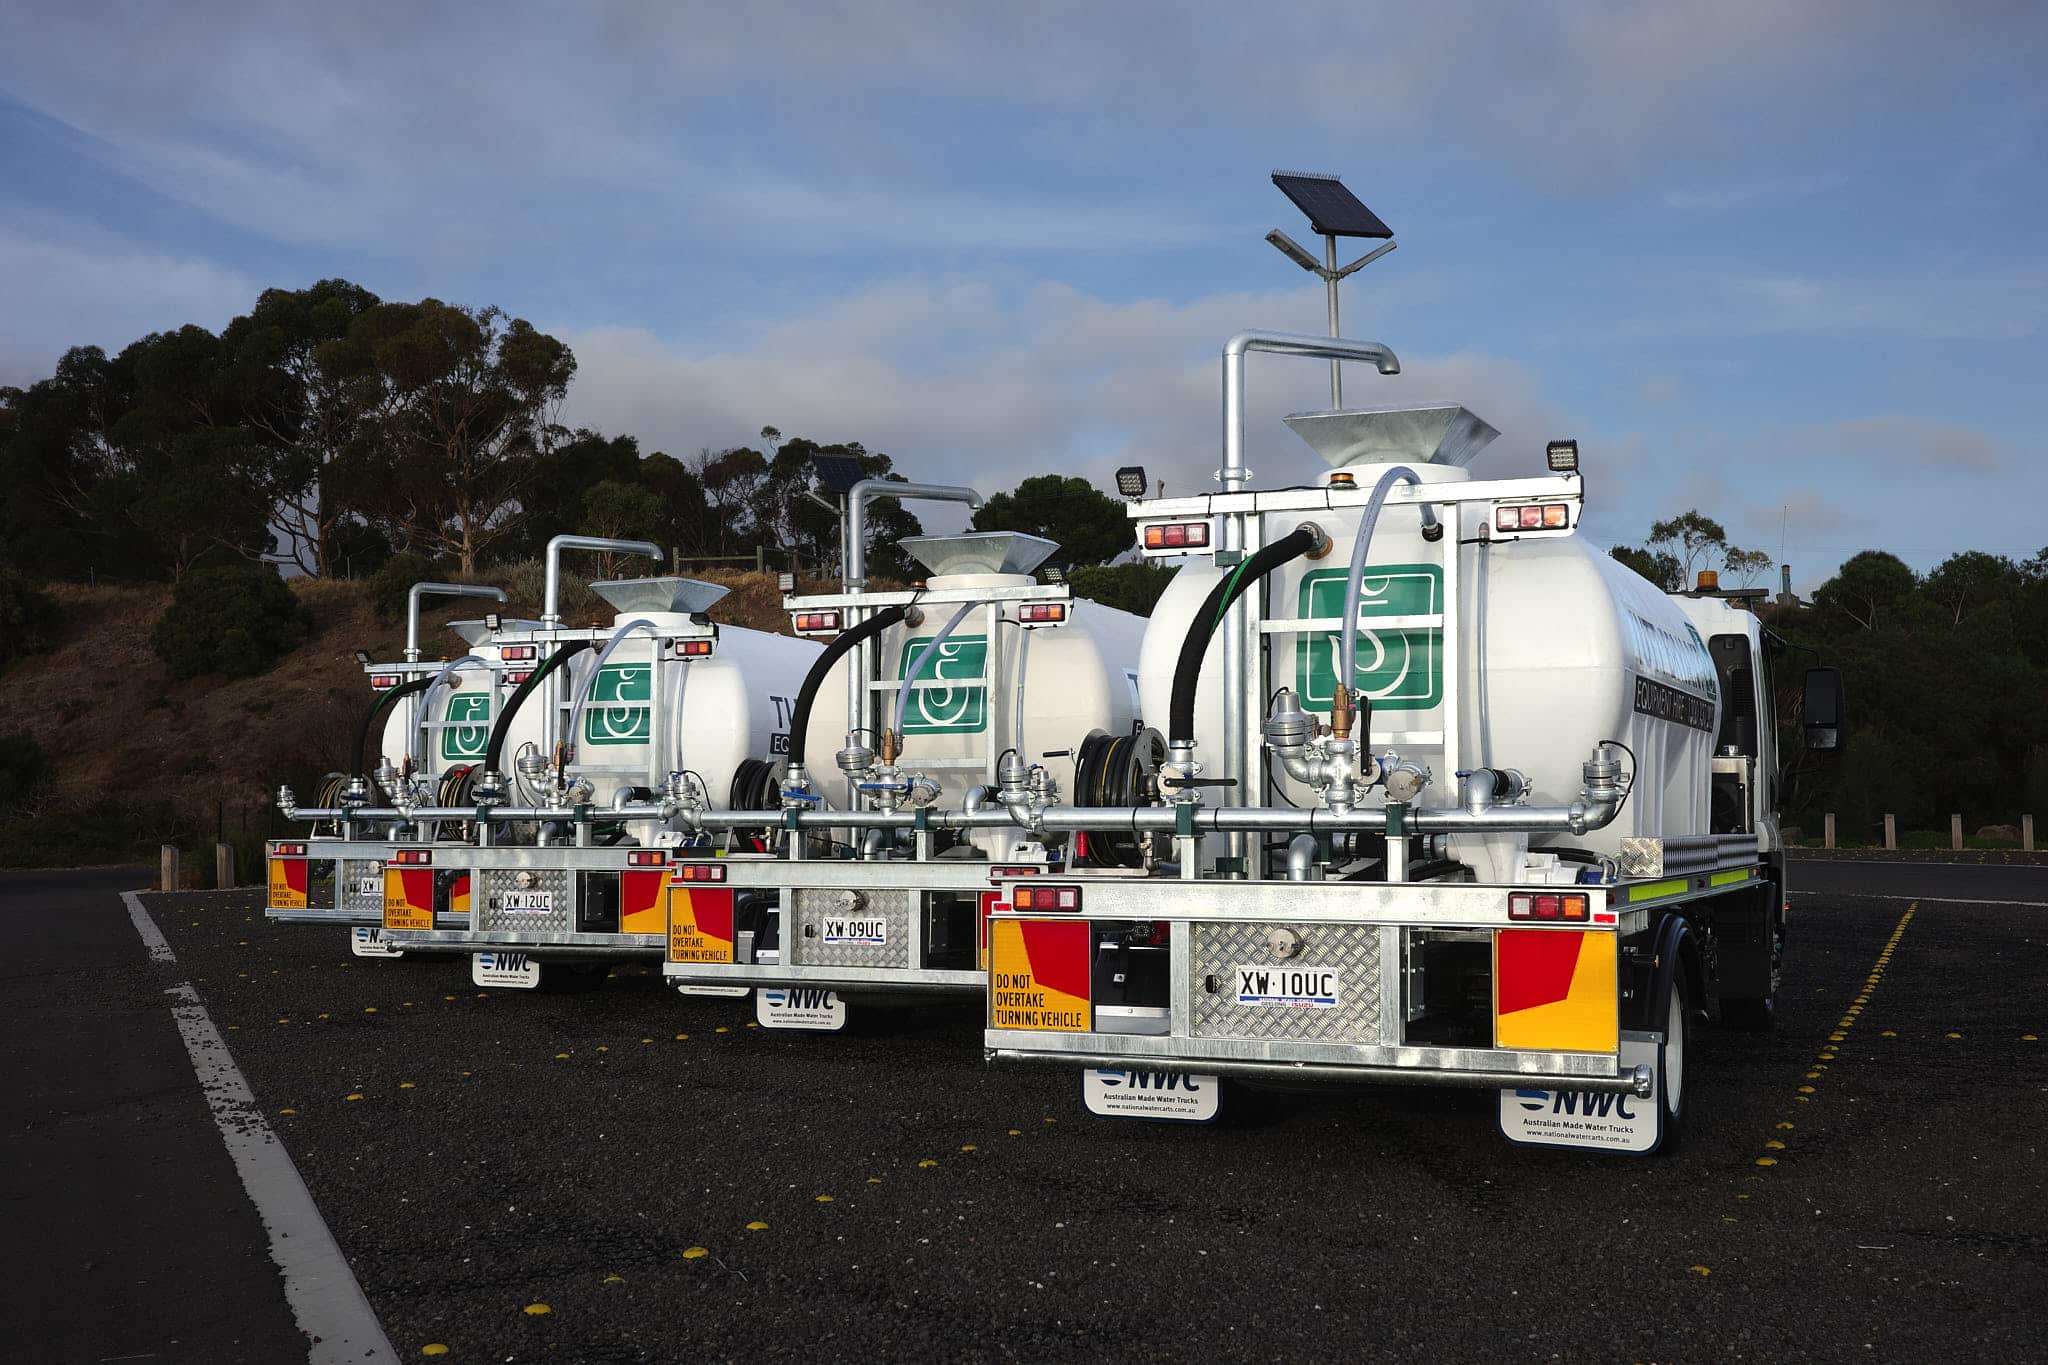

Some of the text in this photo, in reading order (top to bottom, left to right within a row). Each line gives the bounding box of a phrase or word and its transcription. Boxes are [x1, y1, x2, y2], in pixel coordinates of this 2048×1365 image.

[506, 895, 550, 908] XW 12UC
[673, 925, 695, 935] DO NOT
[673, 938, 704, 948] OVERTAKE
[673, 950, 728, 960] TURNING VEHICLE
[996, 974, 1030, 989] DO NOT
[788, 989, 834, 1010] NWC
[996, 992, 1044, 1008] OVERTAKE
[996, 1010, 1082, 1027] TURNING VEHICLE
[1128, 1071, 1200, 1092] NWC
[1104, 1093, 1136, 1101] Australian
[1138, 1094, 1156, 1102] Made
[1176, 1096, 1198, 1104] Trucks
[1553, 1090, 1636, 1120] NWC
[1523, 1118, 1634, 1134] Australian Made Water Trucks
